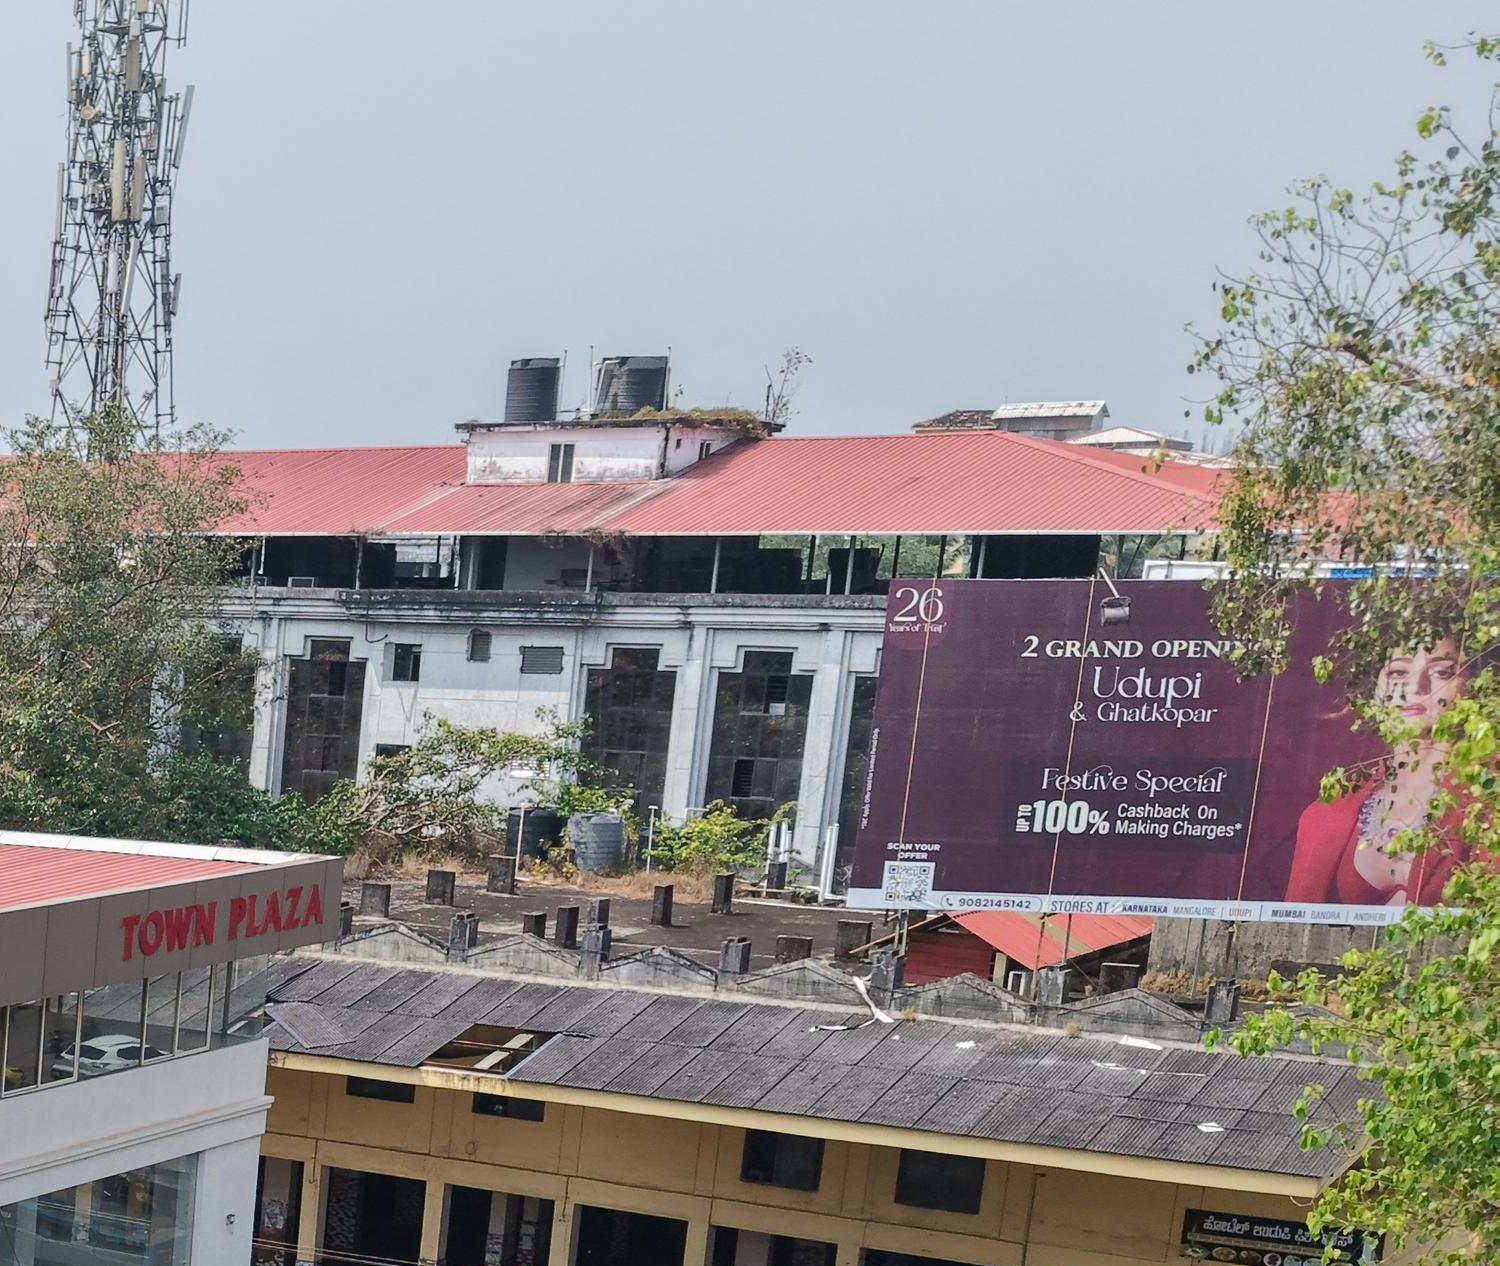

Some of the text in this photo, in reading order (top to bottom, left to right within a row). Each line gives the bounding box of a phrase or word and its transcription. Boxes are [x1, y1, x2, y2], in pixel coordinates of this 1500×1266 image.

[893, 587, 944, 622] 26
[1020, 635, 1040, 658] 2
[1045, 640, 1144, 658] GRAND
[1093, 666, 1202, 708] Udupi
[1069, 701, 1218, 728] & Ghatkopar
[1041, 765, 1227, 797] Festive Special
[1016, 800, 1110, 835] UP TO 100%
[1117, 803, 1218, 820] Cashback On
[1115, 820, 1169, 838] Making
[887, 842, 941, 851] SCAN YOUR
[897, 852, 929, 860] OFFER
[959, 898, 1032, 909] 9082145142
[1051, 900, 1093, 913] STORES
[1095, 902, 1110, 913] AT
[1121, 903, 1168, 914] KARNATAKA
[1172, 906, 1217, 916] MANGALORE
[1271, 909, 1306, 919] MUMBAI
[1311, 910, 1341, 920] BANDRA
[1353, 911, 1387, 922] ANDHERI
[121, 883, 324, 961] TOWN PLAZA
